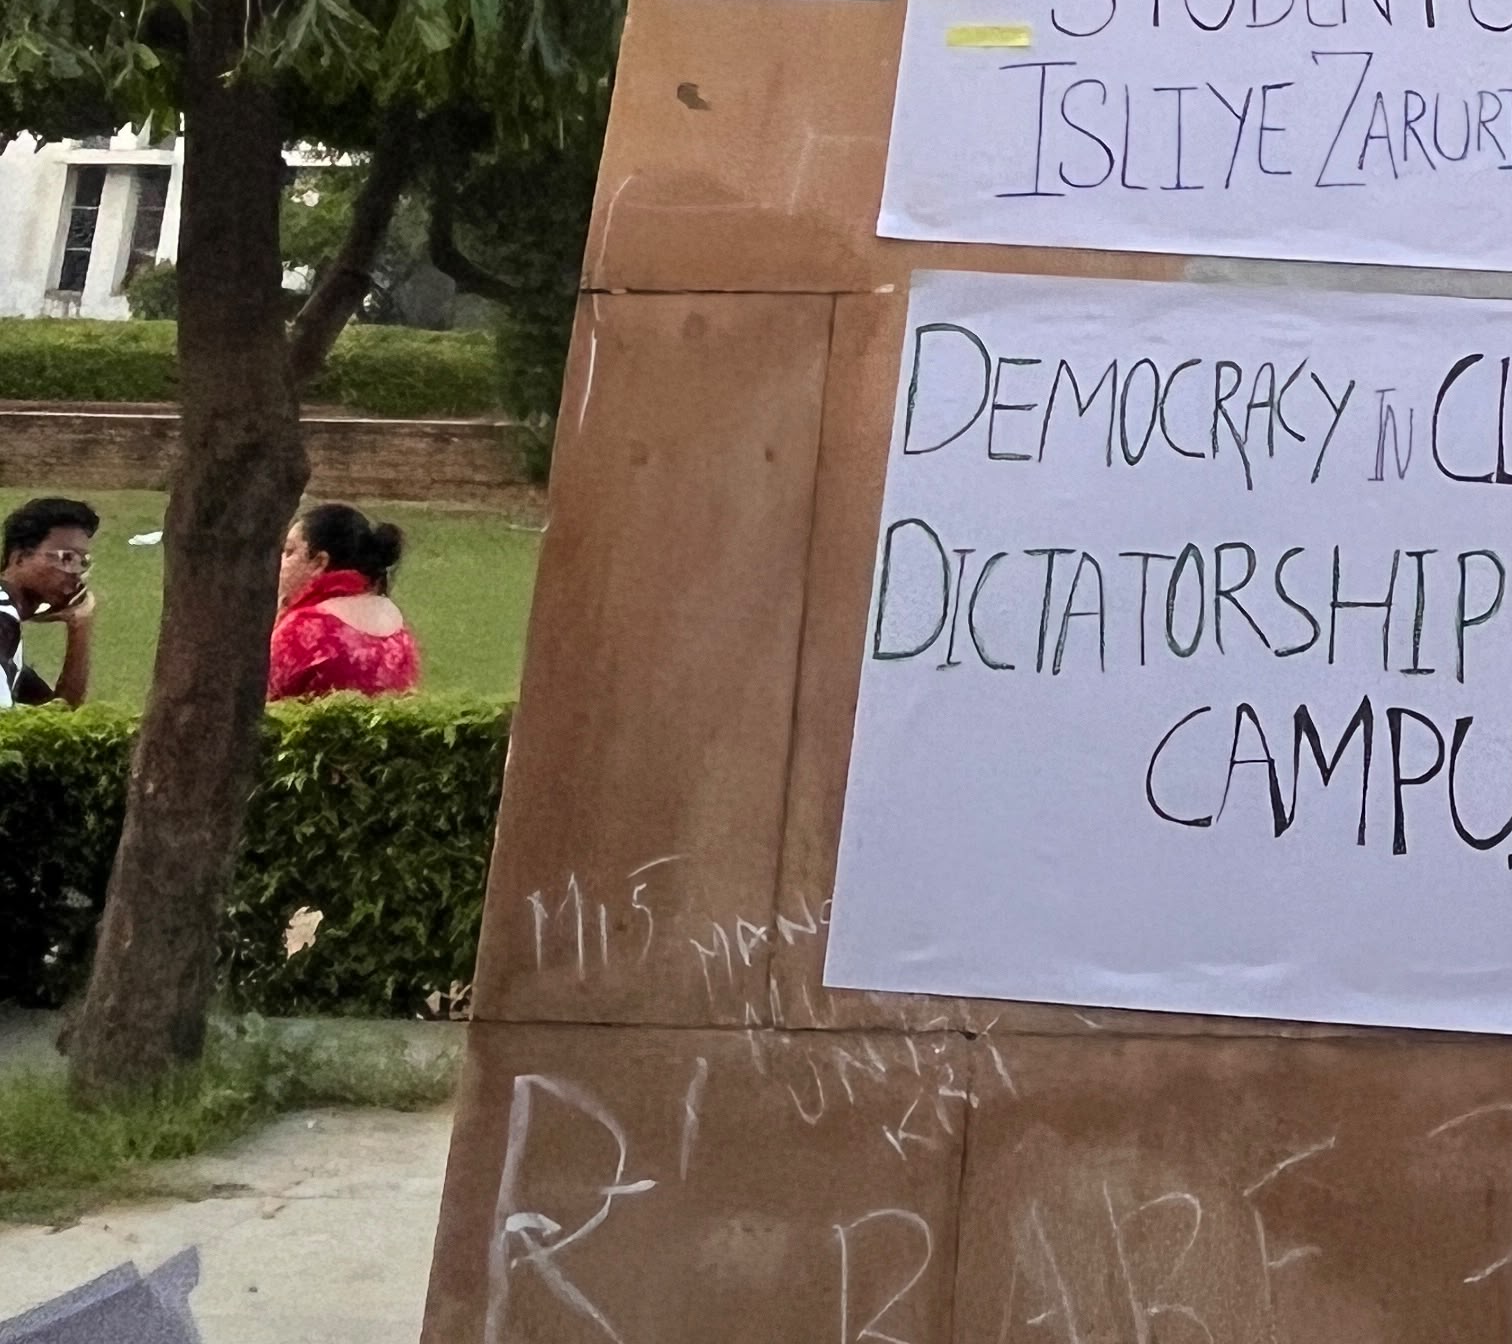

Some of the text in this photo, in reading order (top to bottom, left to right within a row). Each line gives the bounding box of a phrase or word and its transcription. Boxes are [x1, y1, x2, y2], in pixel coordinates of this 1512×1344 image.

[996, 61, 1295, 198] ISLIYE
[903, 322, 1357, 491] DEMOCRACY
[1368, 386, 1415, 482] IN
[871, 518, 1507, 684] DICTATORSHIP
